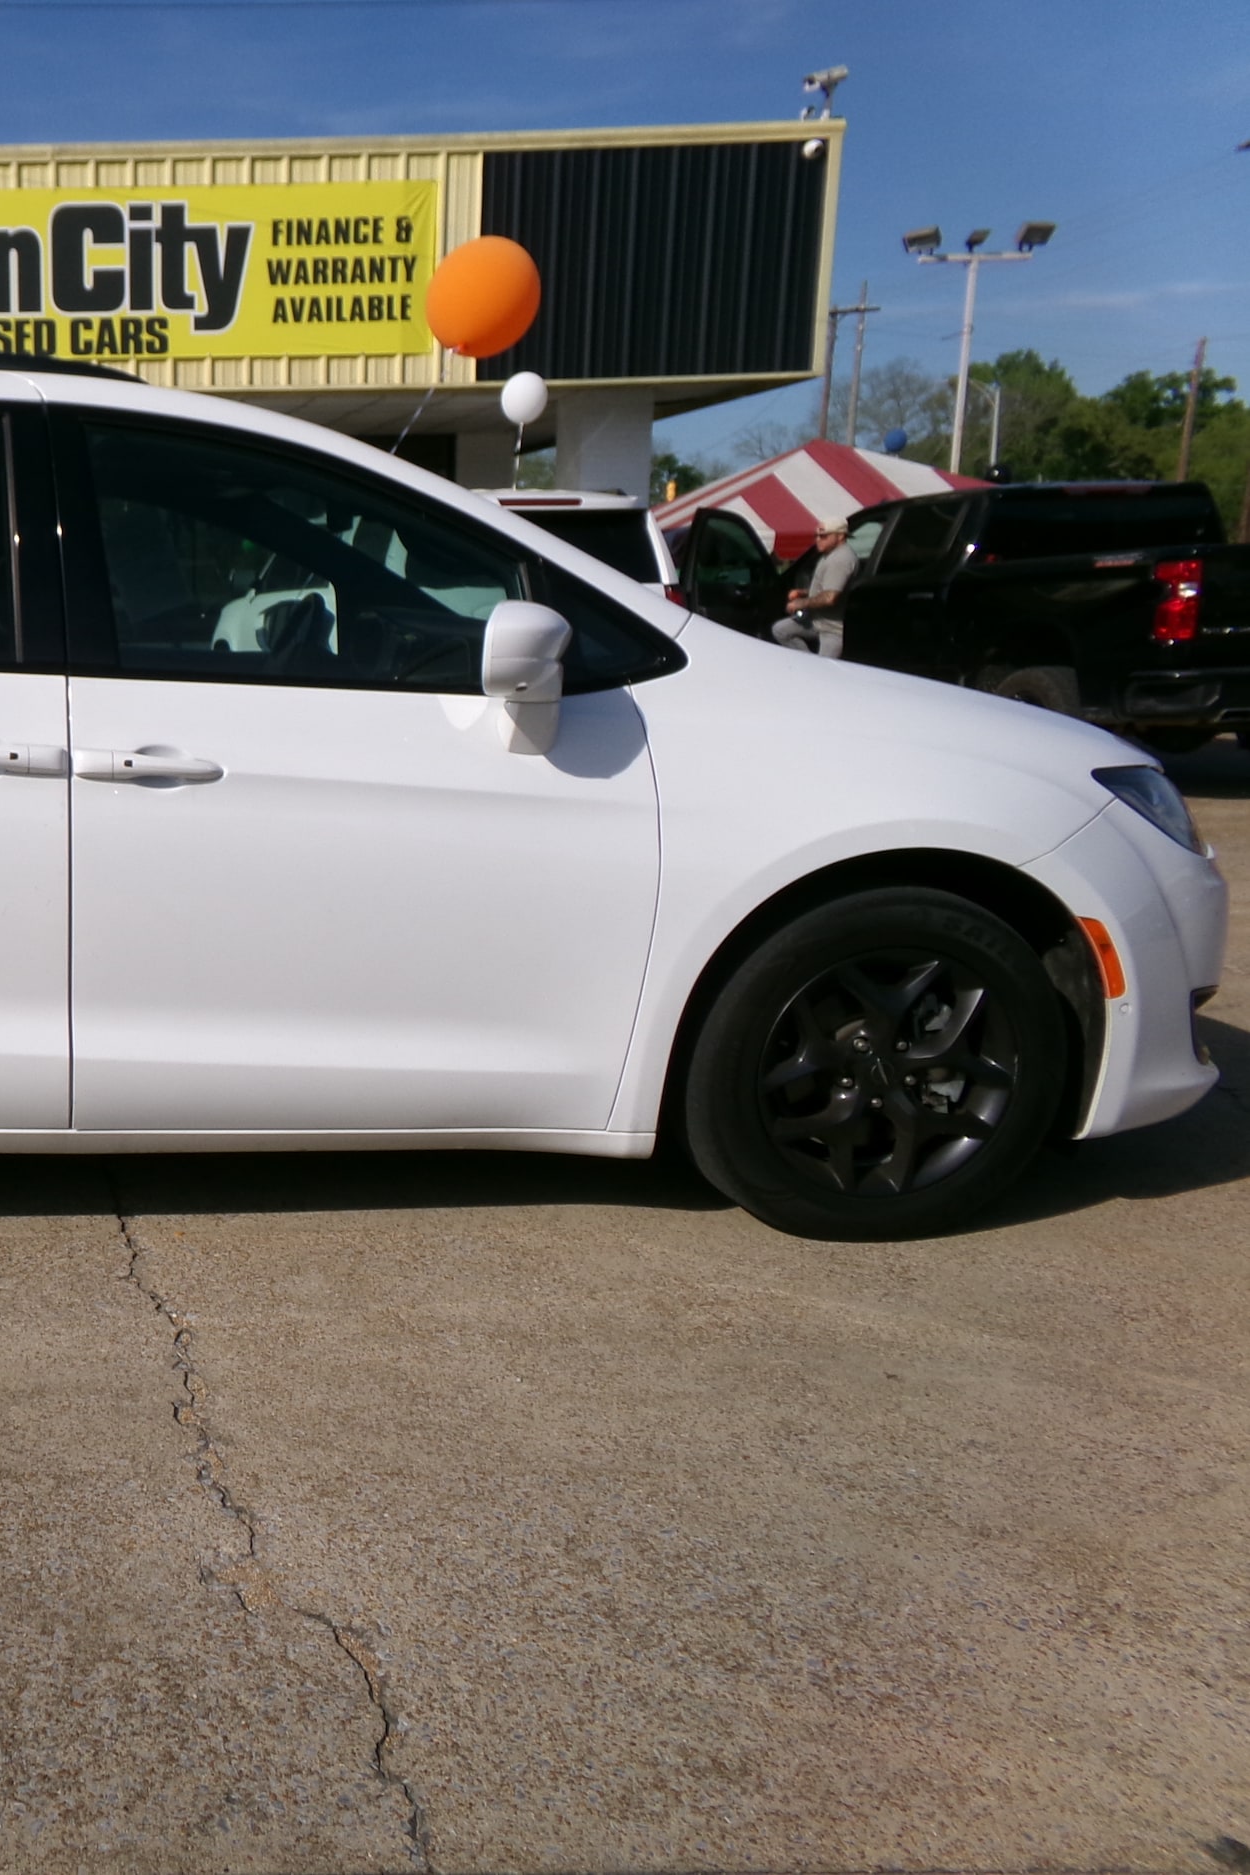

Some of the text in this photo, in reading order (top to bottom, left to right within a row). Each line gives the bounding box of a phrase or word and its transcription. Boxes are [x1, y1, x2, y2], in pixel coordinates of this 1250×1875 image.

[272, 215, 413, 246] FINANCE &
[267, 255, 417, 286] WARRANTY
[272, 294, 412, 324] AVAILABLE
[70, 317, 169, 355] CARS
